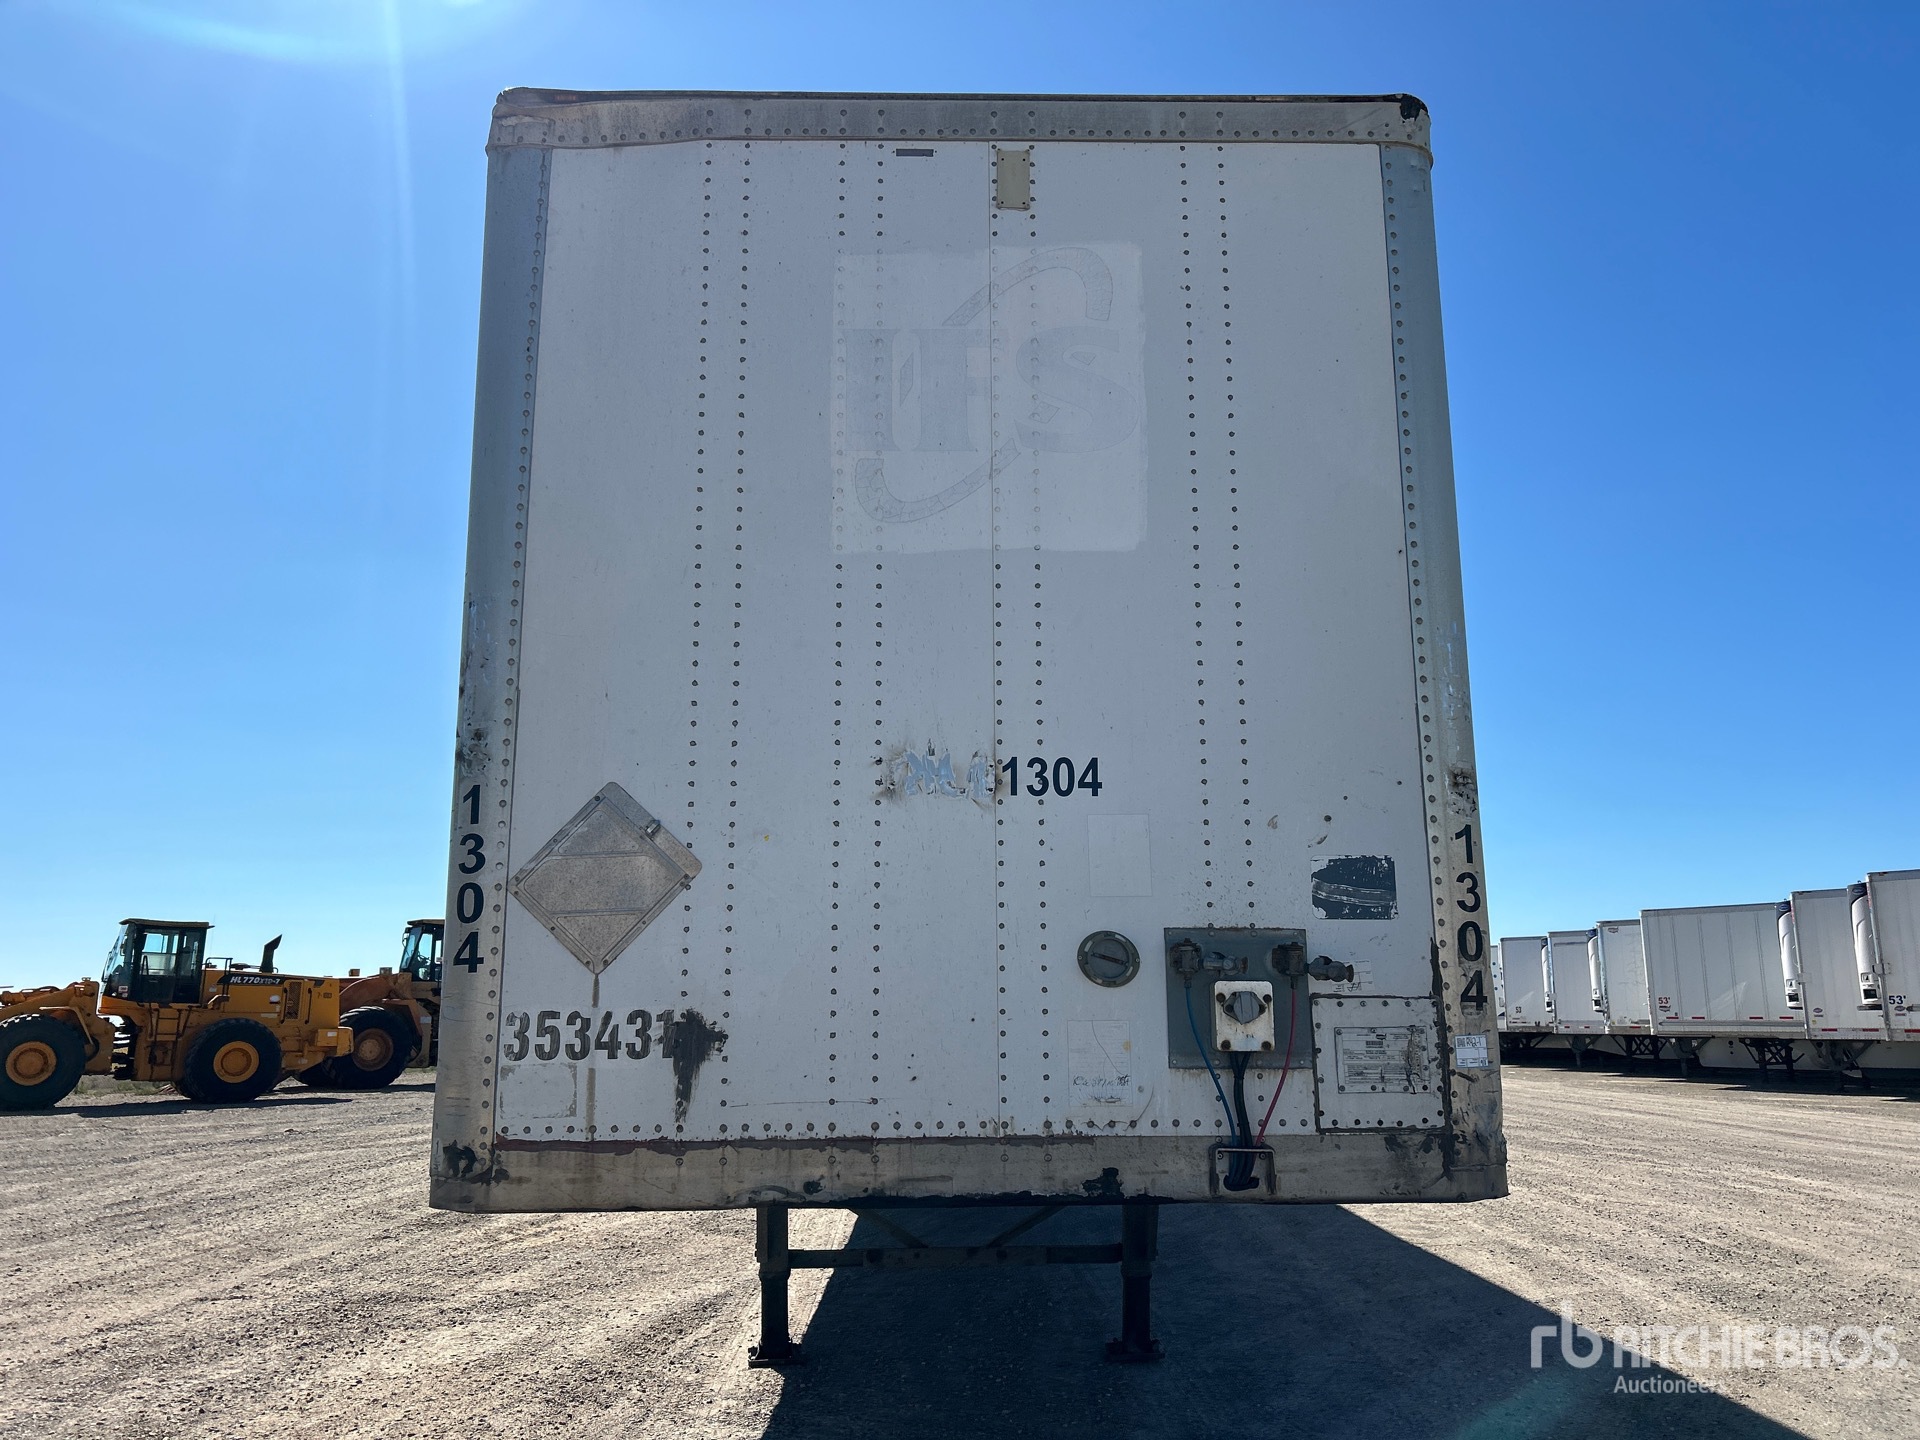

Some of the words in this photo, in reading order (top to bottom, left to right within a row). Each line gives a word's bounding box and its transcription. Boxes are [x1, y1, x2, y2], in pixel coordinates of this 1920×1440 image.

[1002, 756, 1103, 797] 1304
[453, 784, 486, 974] 1304
[1454, 823, 1488, 1012] 1304
[1888, 994, 1907, 1005] 53'
